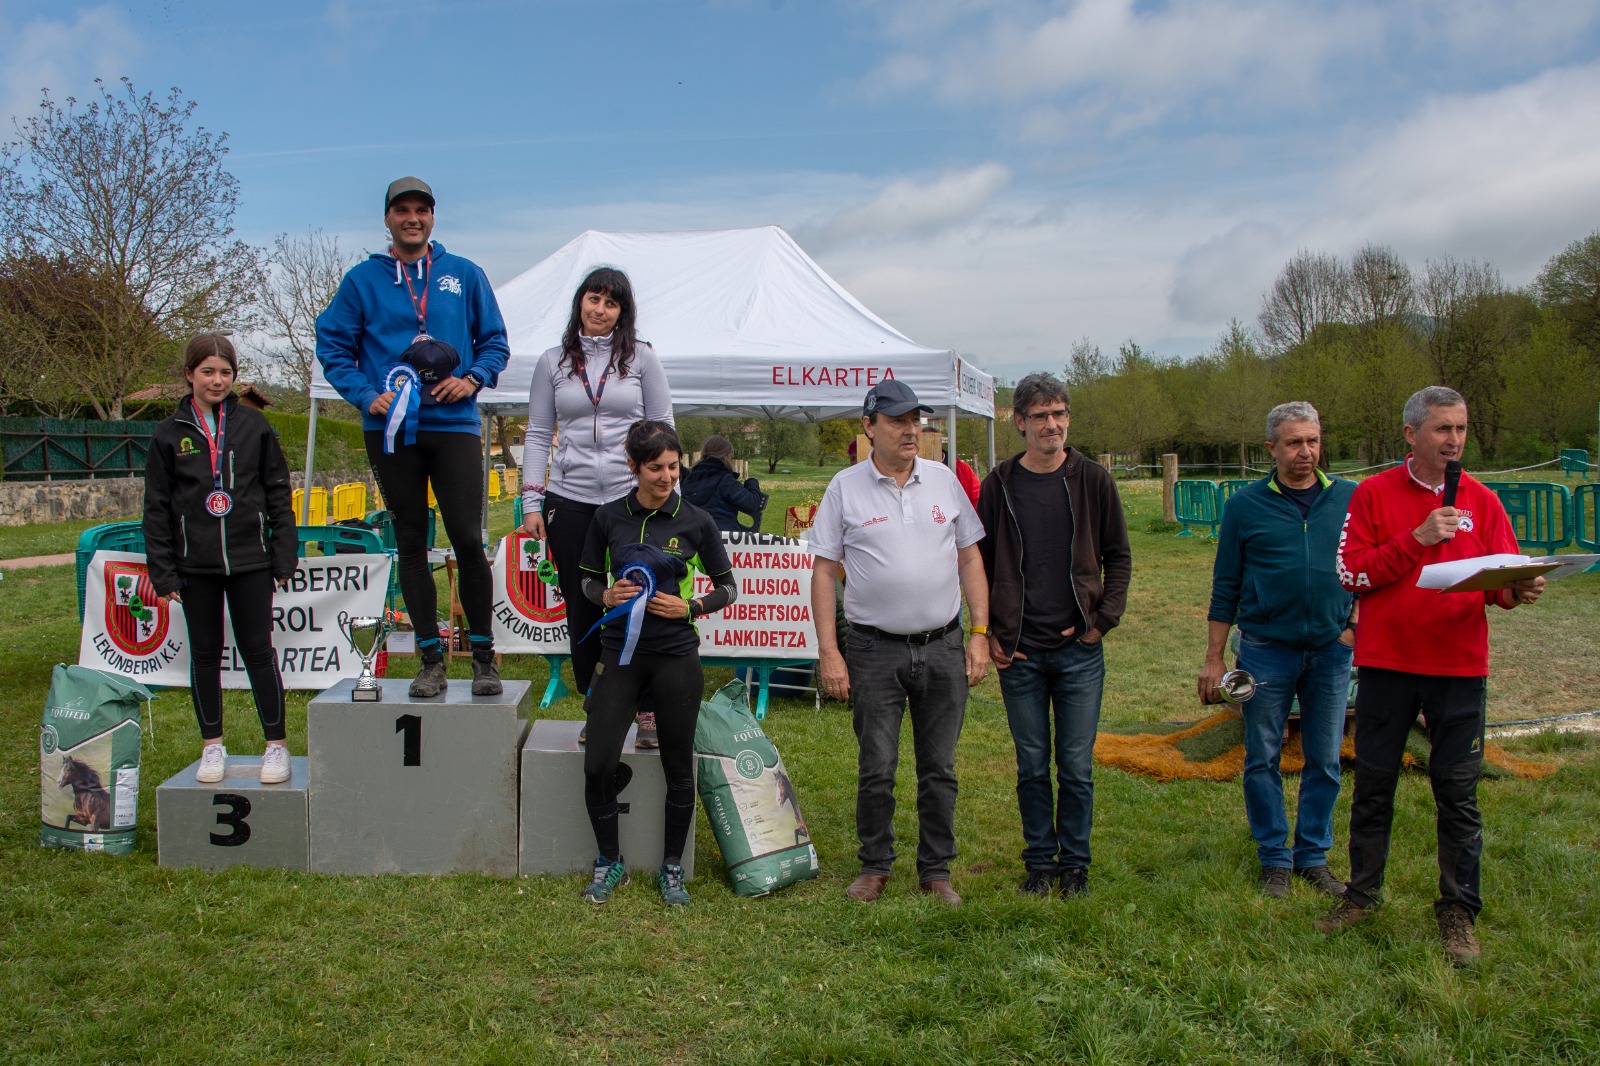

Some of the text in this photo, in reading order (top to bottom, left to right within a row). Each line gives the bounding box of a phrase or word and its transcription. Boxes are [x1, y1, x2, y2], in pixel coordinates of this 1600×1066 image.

[772, 366, 896, 387] ELKARTEA
[742, 578, 800, 595] ILUSIOA
[723, 604, 810, 622] DIBERTSIOA
[714, 629, 807, 648] LANKIDETZA
[92, 632, 183, 675] LEKUNBERRI K.E.
[220, 646, 341, 673] ELRTEA
[395, 713, 422, 767] 1
[209, 793, 252, 847] 3
